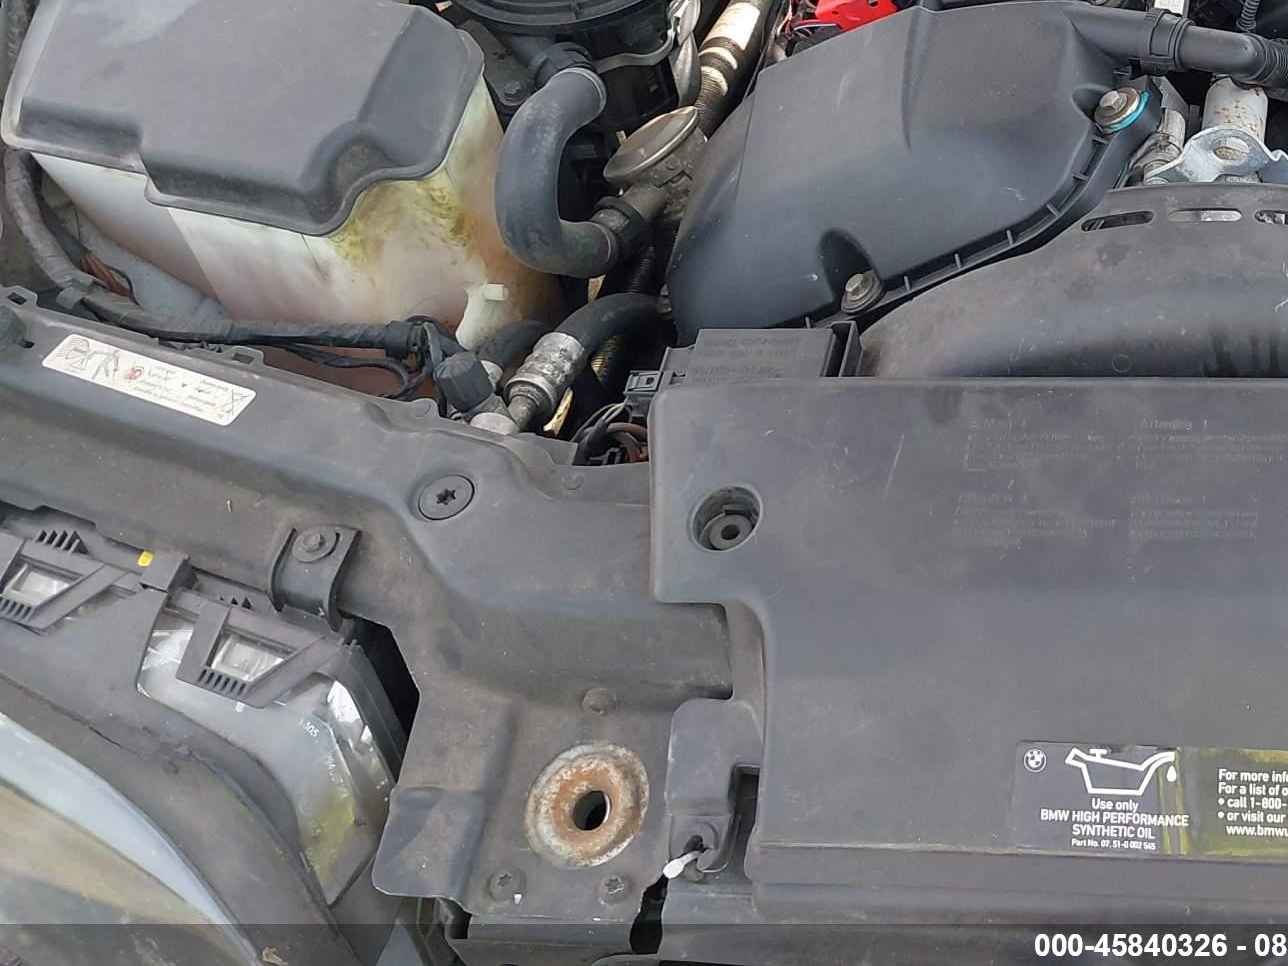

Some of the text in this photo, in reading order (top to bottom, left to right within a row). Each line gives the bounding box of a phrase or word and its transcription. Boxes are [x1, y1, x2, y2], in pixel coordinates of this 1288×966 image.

[1218, 768, 1239, 782] For
[1240, 771, 1270, 782] more
[1218, 782, 1238, 795] For
[1239, 786, 1247, 795] a
[1249, 784, 1267, 796] list
[1268, 785, 1280, 796] of
[1091, 797, 1140, 813] Use only
[1227, 797, 1248, 808] call
[1040, 808, 1190, 827] BMW HIGH PERFORMANCE
[1227, 812, 1239, 821] or
[1241, 811, 1264, 822] visit
[1266, 814, 1287, 824] our
[1072, 823, 1156, 840] SYNTHETIC OIL
[1071, 838, 1087, 847] Part
[1087, 839, 1100, 848] No.
